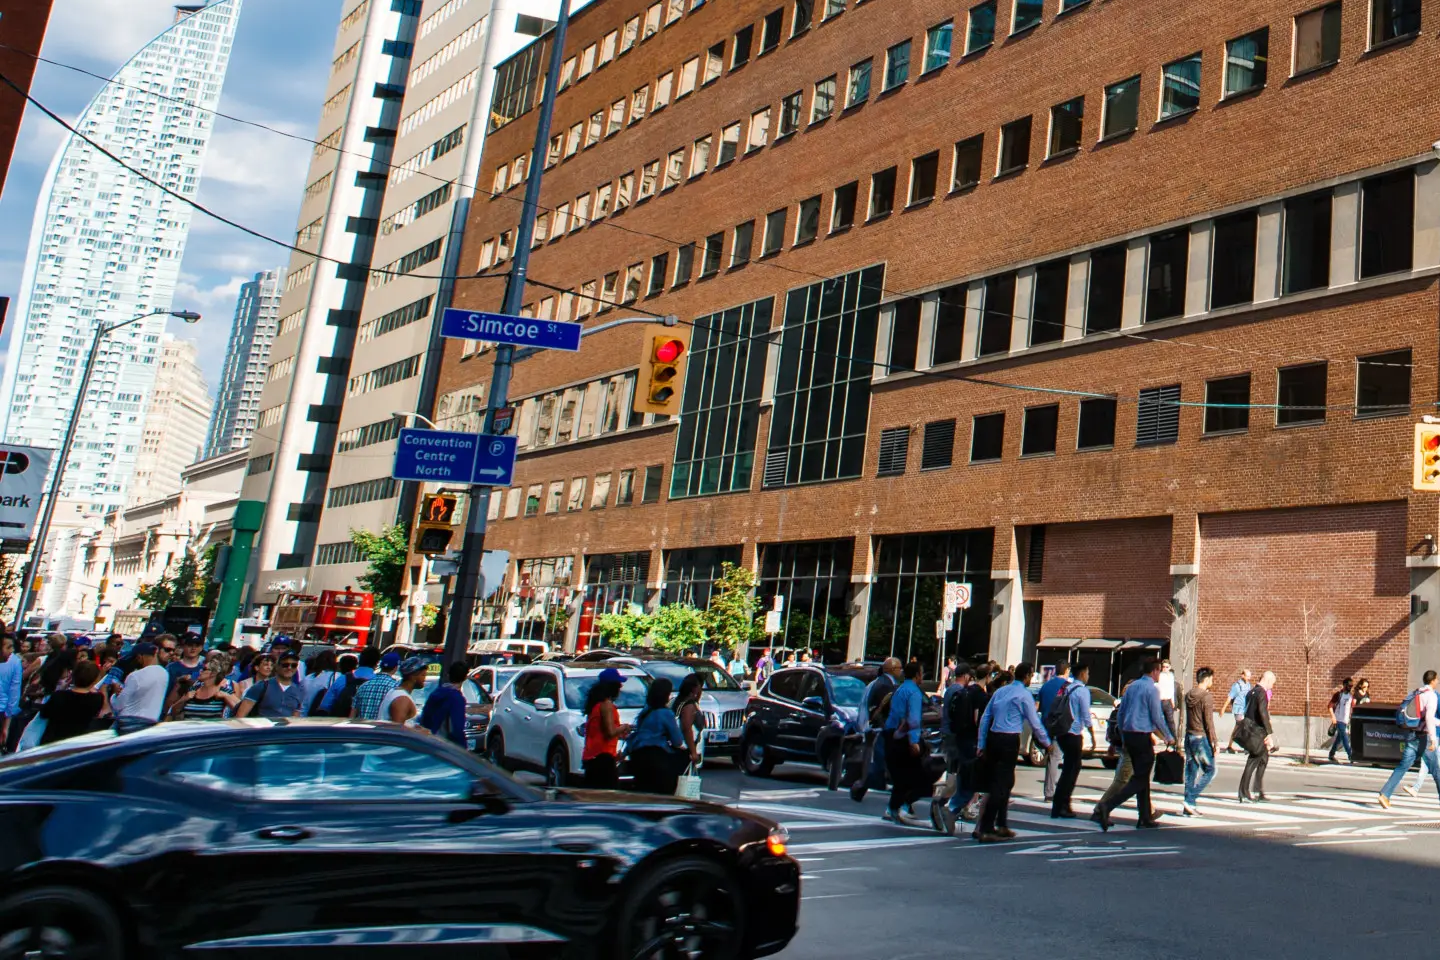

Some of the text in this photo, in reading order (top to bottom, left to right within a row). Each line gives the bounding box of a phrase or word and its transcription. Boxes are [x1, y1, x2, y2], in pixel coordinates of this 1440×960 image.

[467, 313, 557, 339] Simcoe St
[404, 434, 472, 449] Convention
[415, 450, 456, 462] Centre
[415, 464, 451, 477] North
